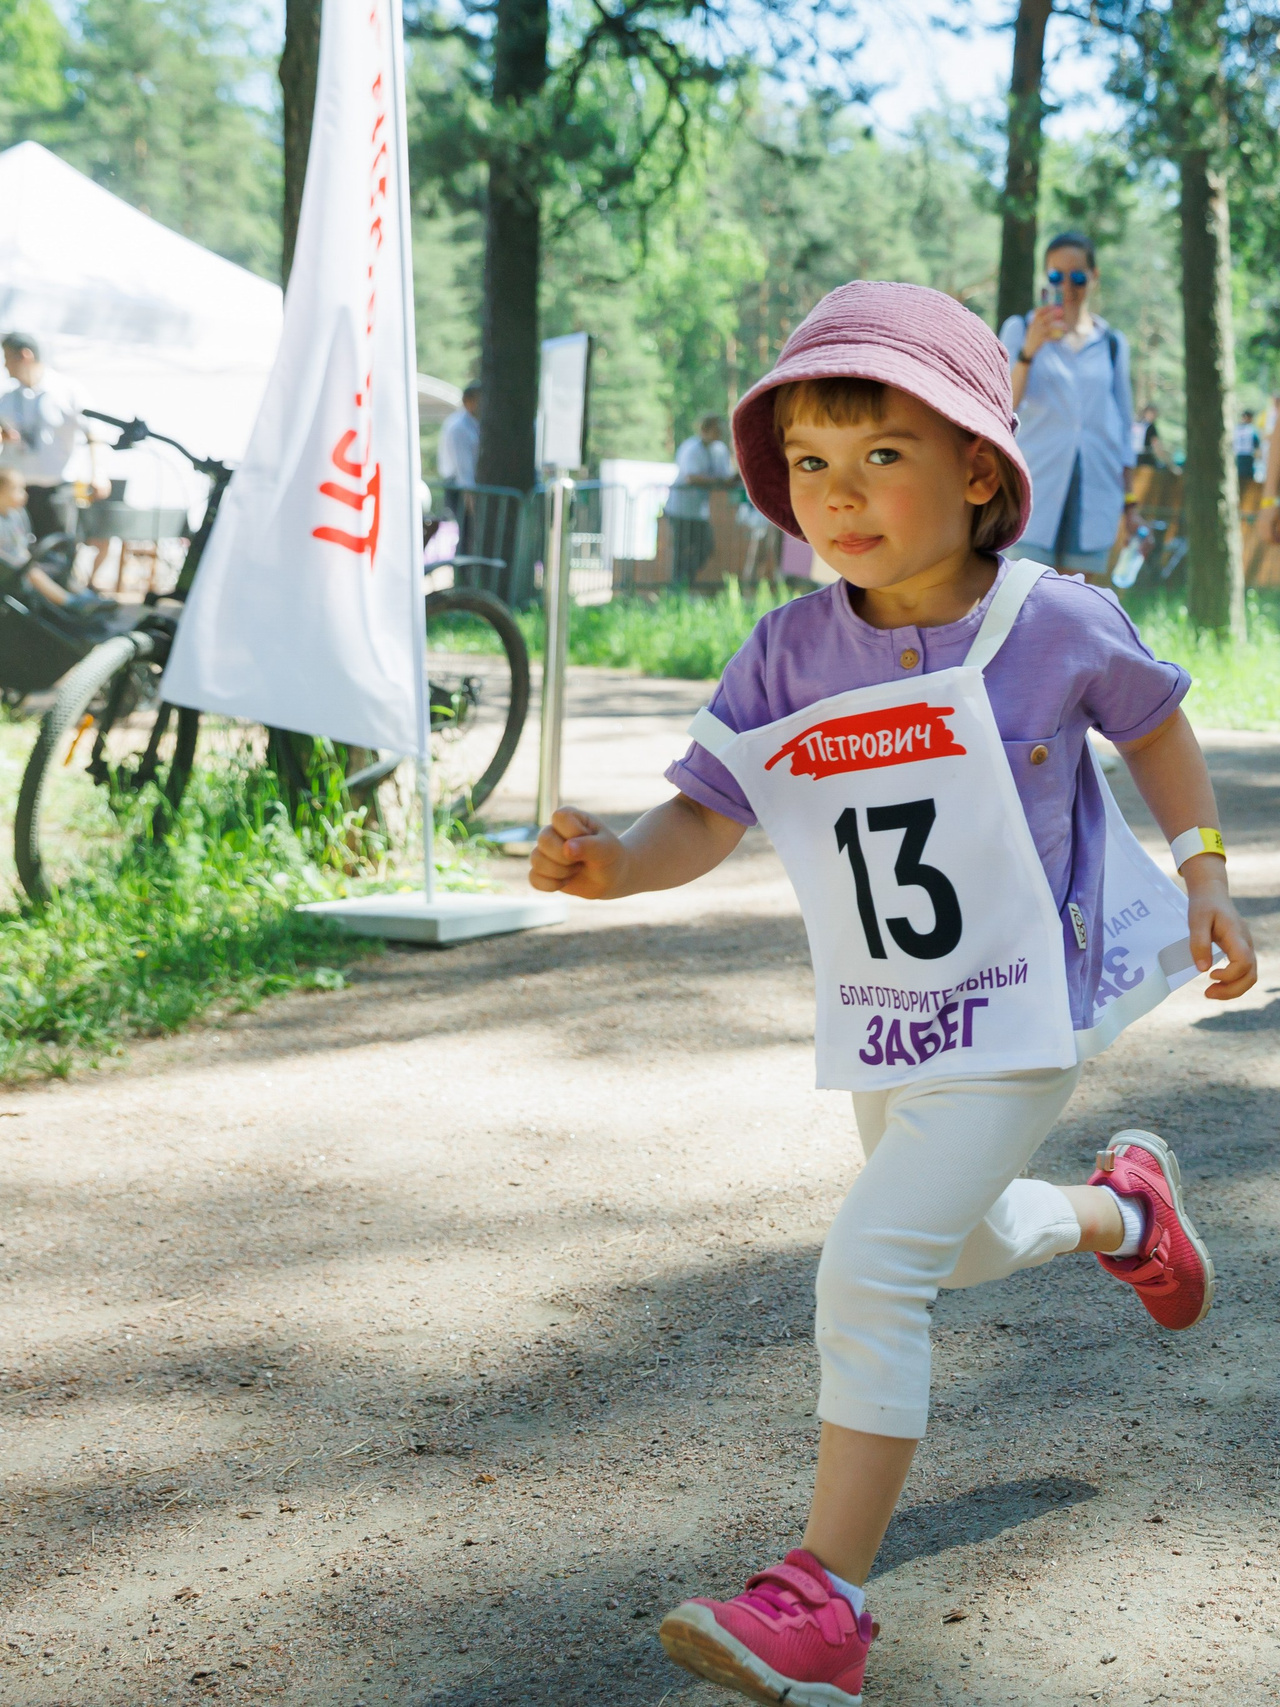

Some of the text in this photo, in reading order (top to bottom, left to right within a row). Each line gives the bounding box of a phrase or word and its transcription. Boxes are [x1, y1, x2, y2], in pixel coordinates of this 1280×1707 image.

[798, 723, 932, 762] ПЕТРОВИЧ
[834, 797, 963, 960] 13
[858, 997, 989, 1066] ЗАБЕГ
